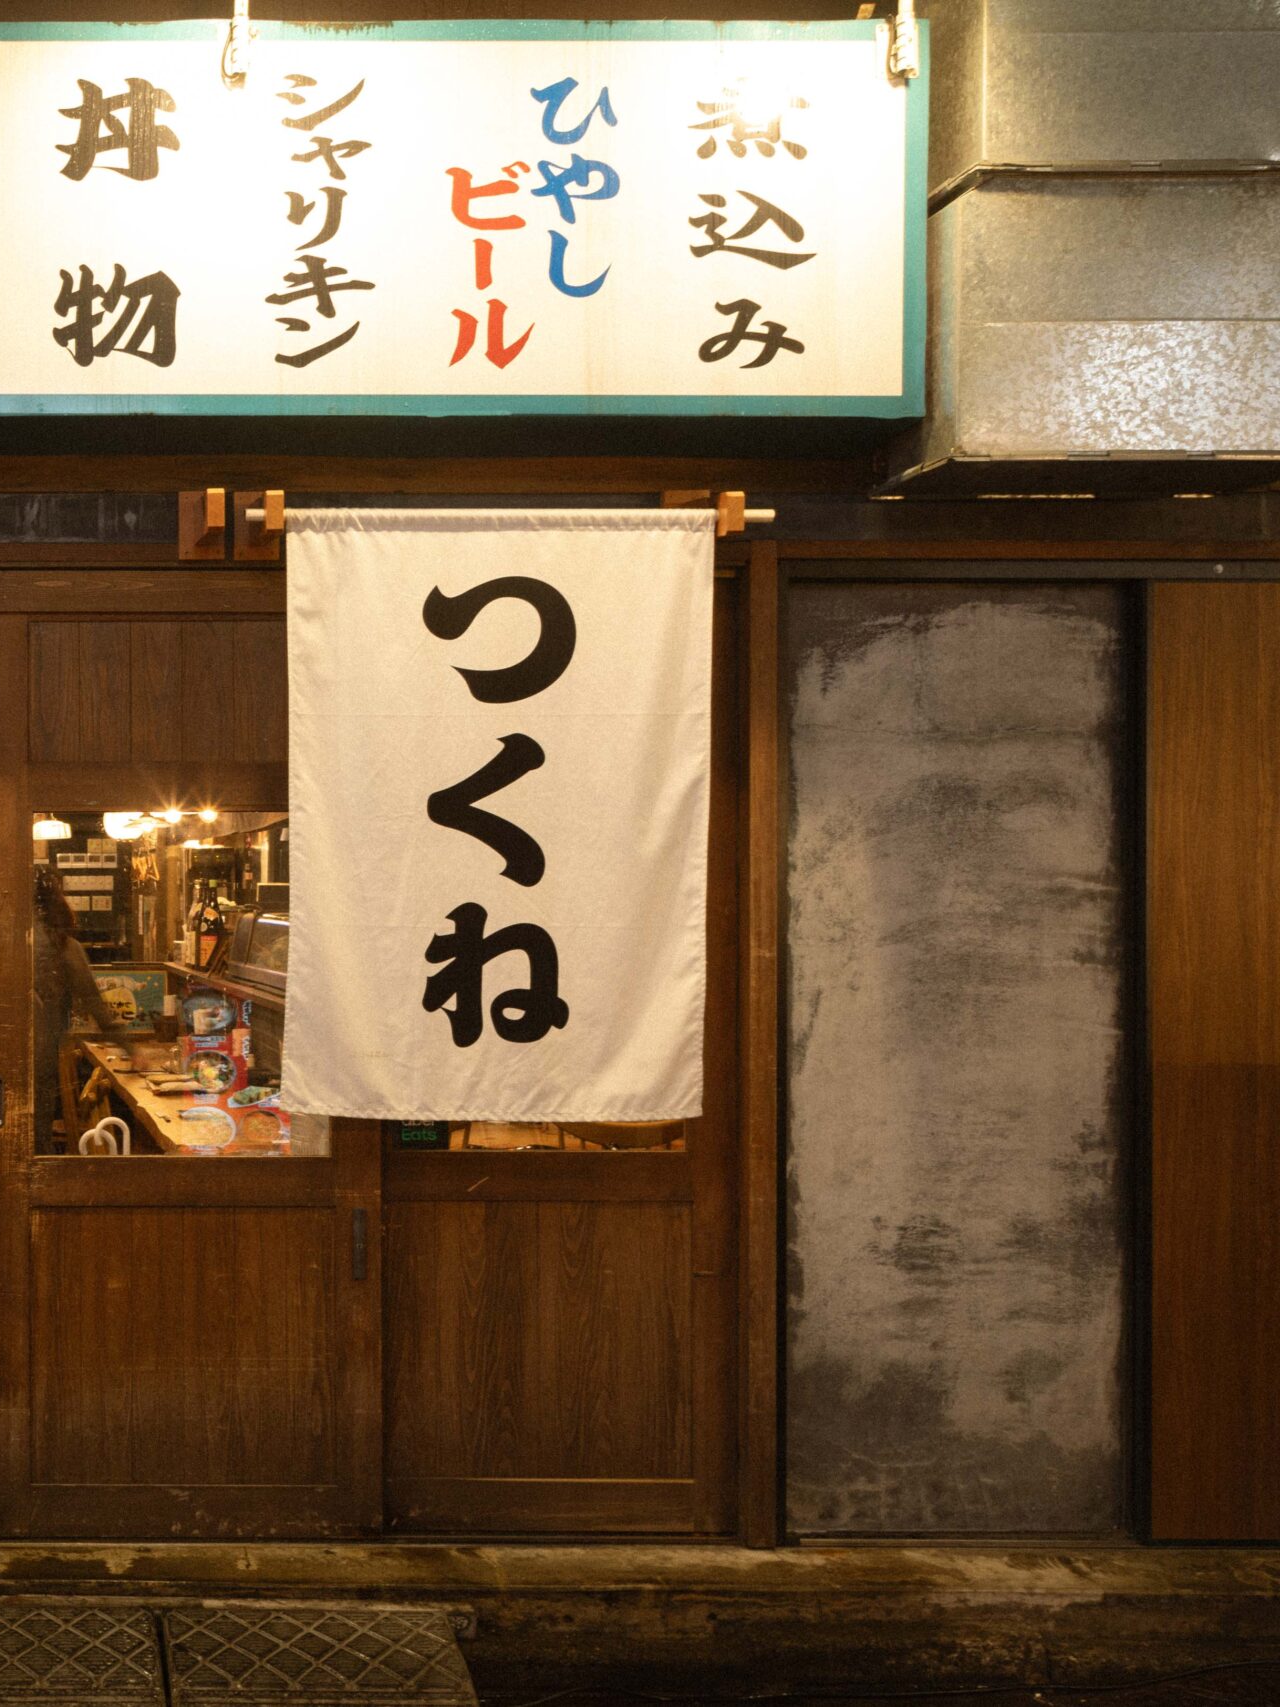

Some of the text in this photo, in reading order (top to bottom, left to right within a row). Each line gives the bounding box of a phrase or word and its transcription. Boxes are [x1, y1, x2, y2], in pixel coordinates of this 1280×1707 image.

[52, 77, 181, 367] 丼物
[265, 74, 376, 369] シャリキン
[445, 160, 536, 370] ビール
[530, 76, 620, 299] ひやし
[687, 80, 818, 370] 煮込み
[421, 575, 577, 1049] つくね
[402, 1129, 437, 1141] Eats
